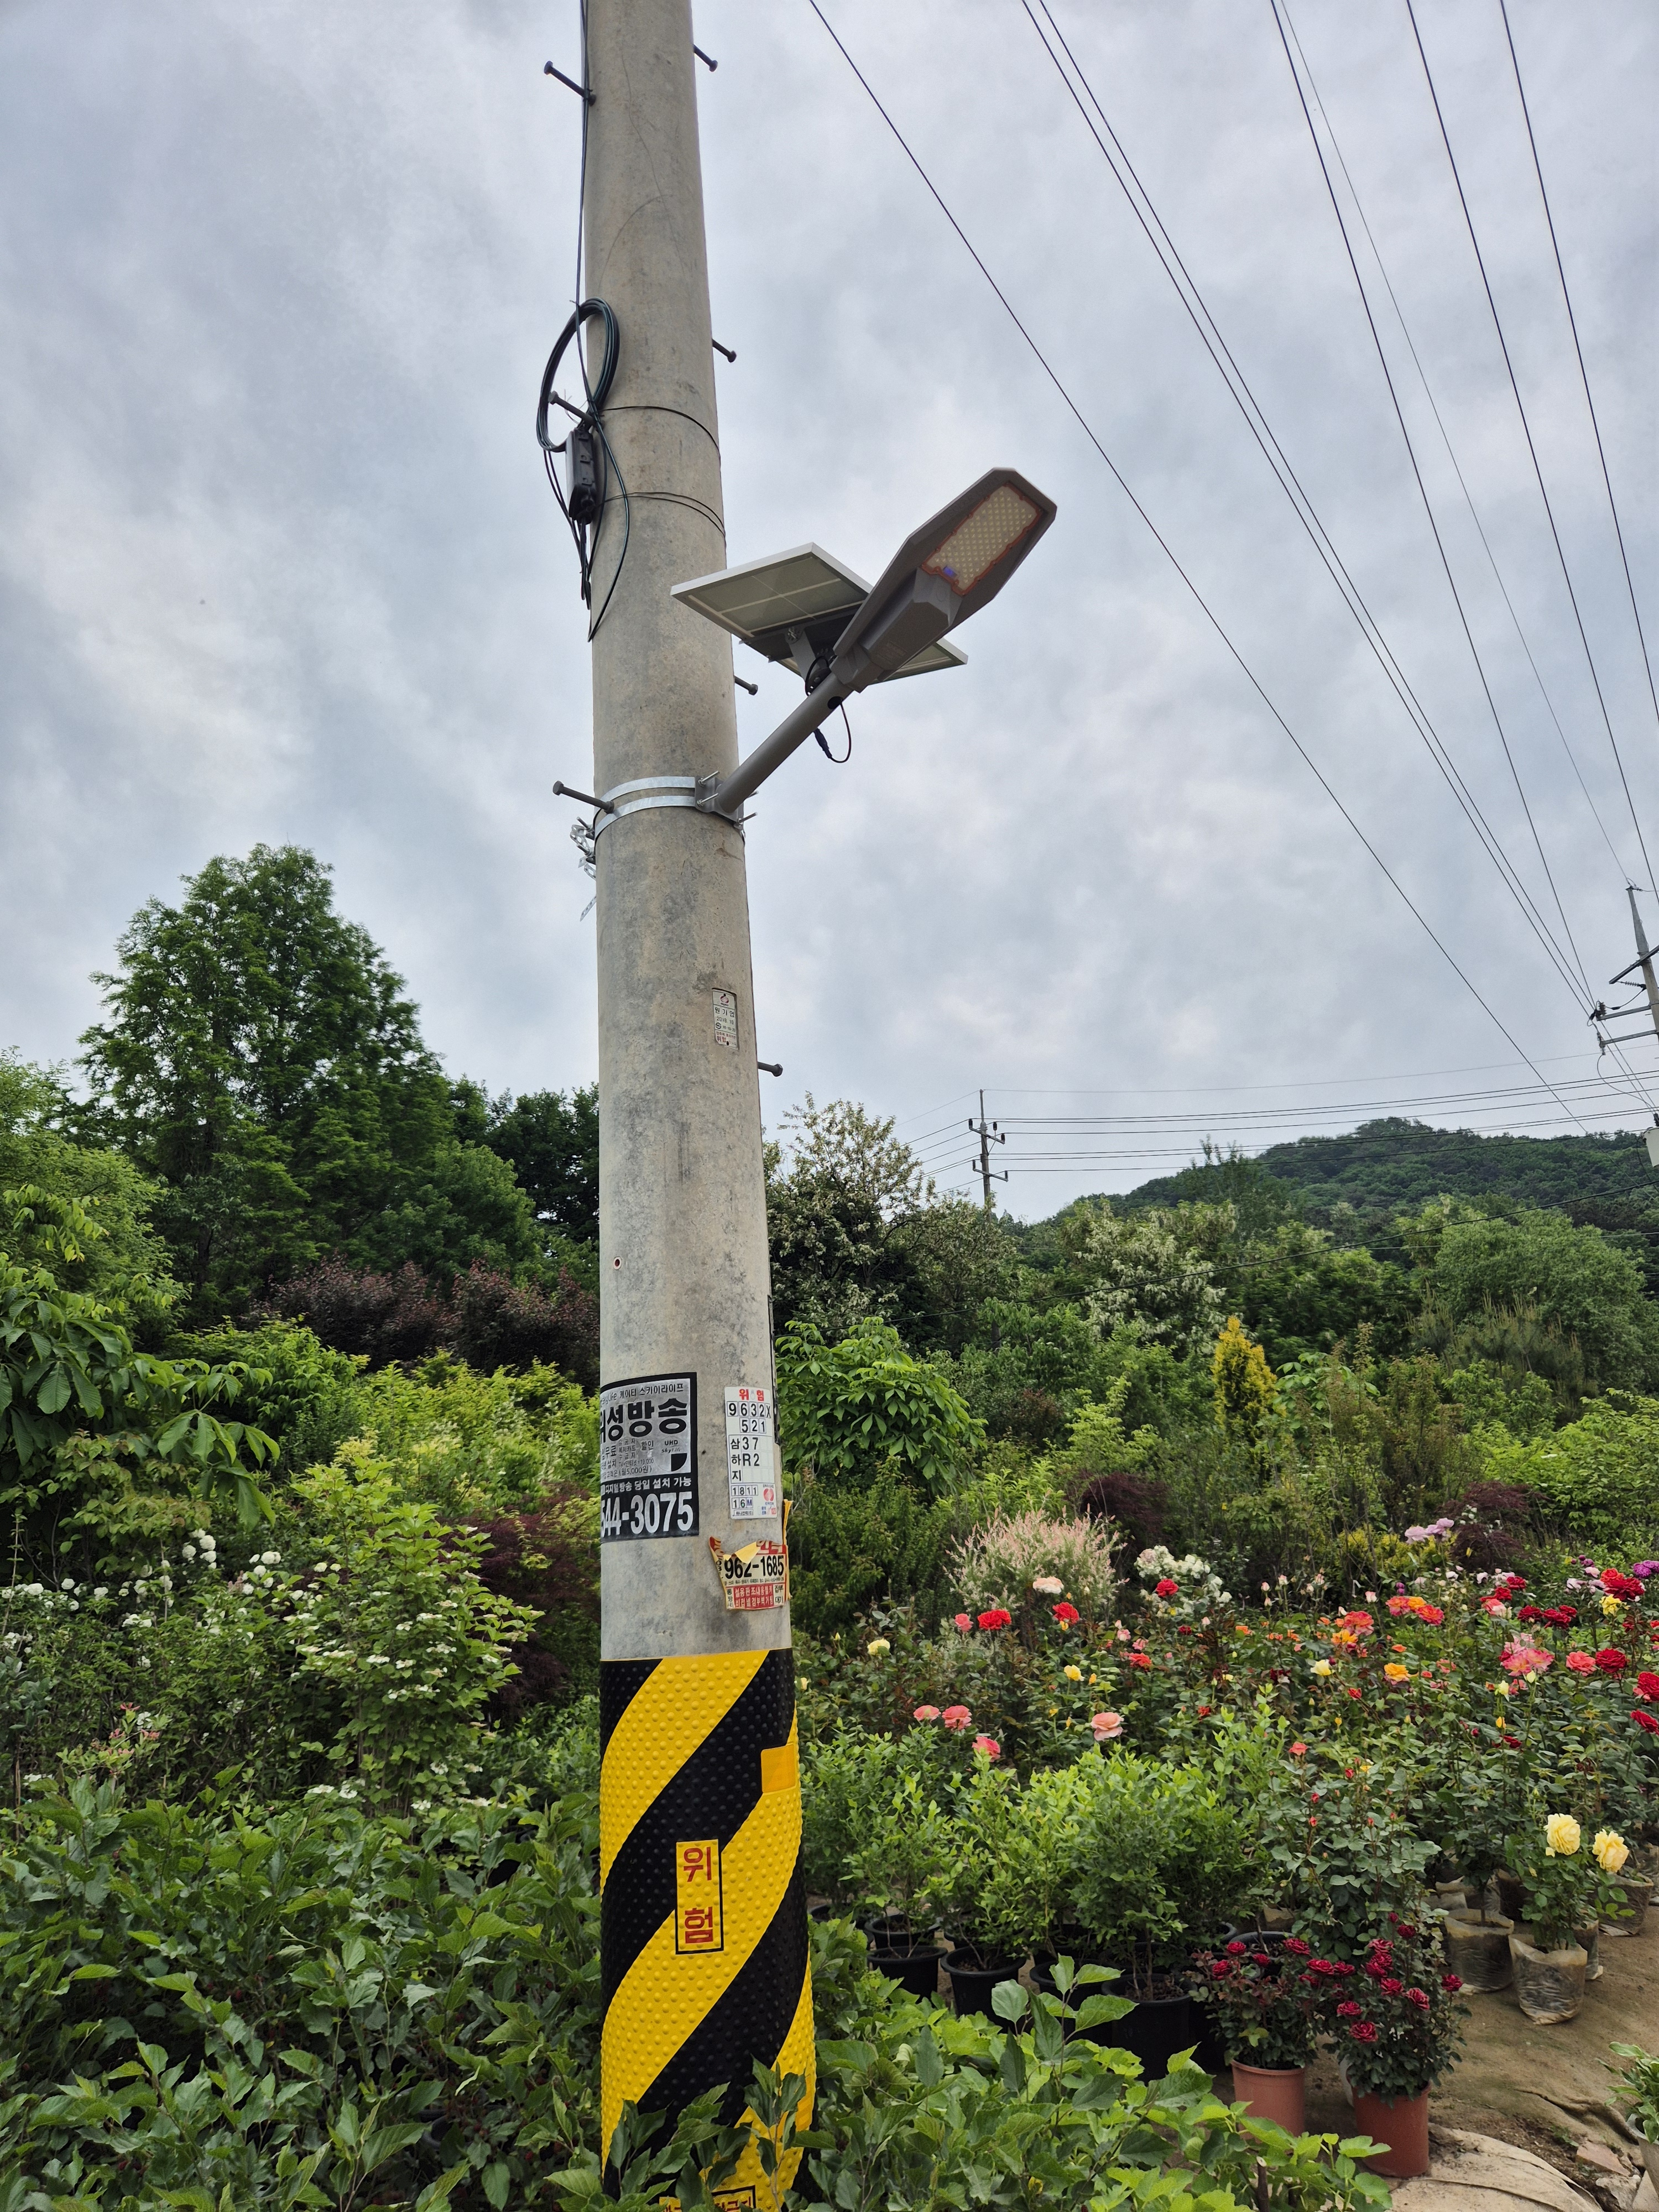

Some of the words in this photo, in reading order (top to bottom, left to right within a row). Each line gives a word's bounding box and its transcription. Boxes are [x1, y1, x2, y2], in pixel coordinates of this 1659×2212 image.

[619, 1389, 637, 1399] 케이티
[639, 1384, 684, 1395] 스카이라이프
[739, 1389, 764, 1402] 위험
[600, 1398, 687, 1443] 위성방송
[742, 1420, 765, 1433] 521
[641, 1440, 654, 1451] 할인
[731, 1438, 740, 1449] 삼
[742, 1437, 759, 1450] 37
[731, 1454, 742, 1465] 하
[742, 1453, 760, 1467] R2
[732, 1470, 742, 1481] 지
[635, 1479, 650, 1491] 당일
[653, 1478, 670, 1489] 설치
[674, 1477, 691, 1487] 가능
[732, 1486, 757, 1495] 1811
[733, 1499, 752, 1508] 16M
[724, 1555, 784, 1579] 962-1685
[684, 1846, 713, 1944] 위험
